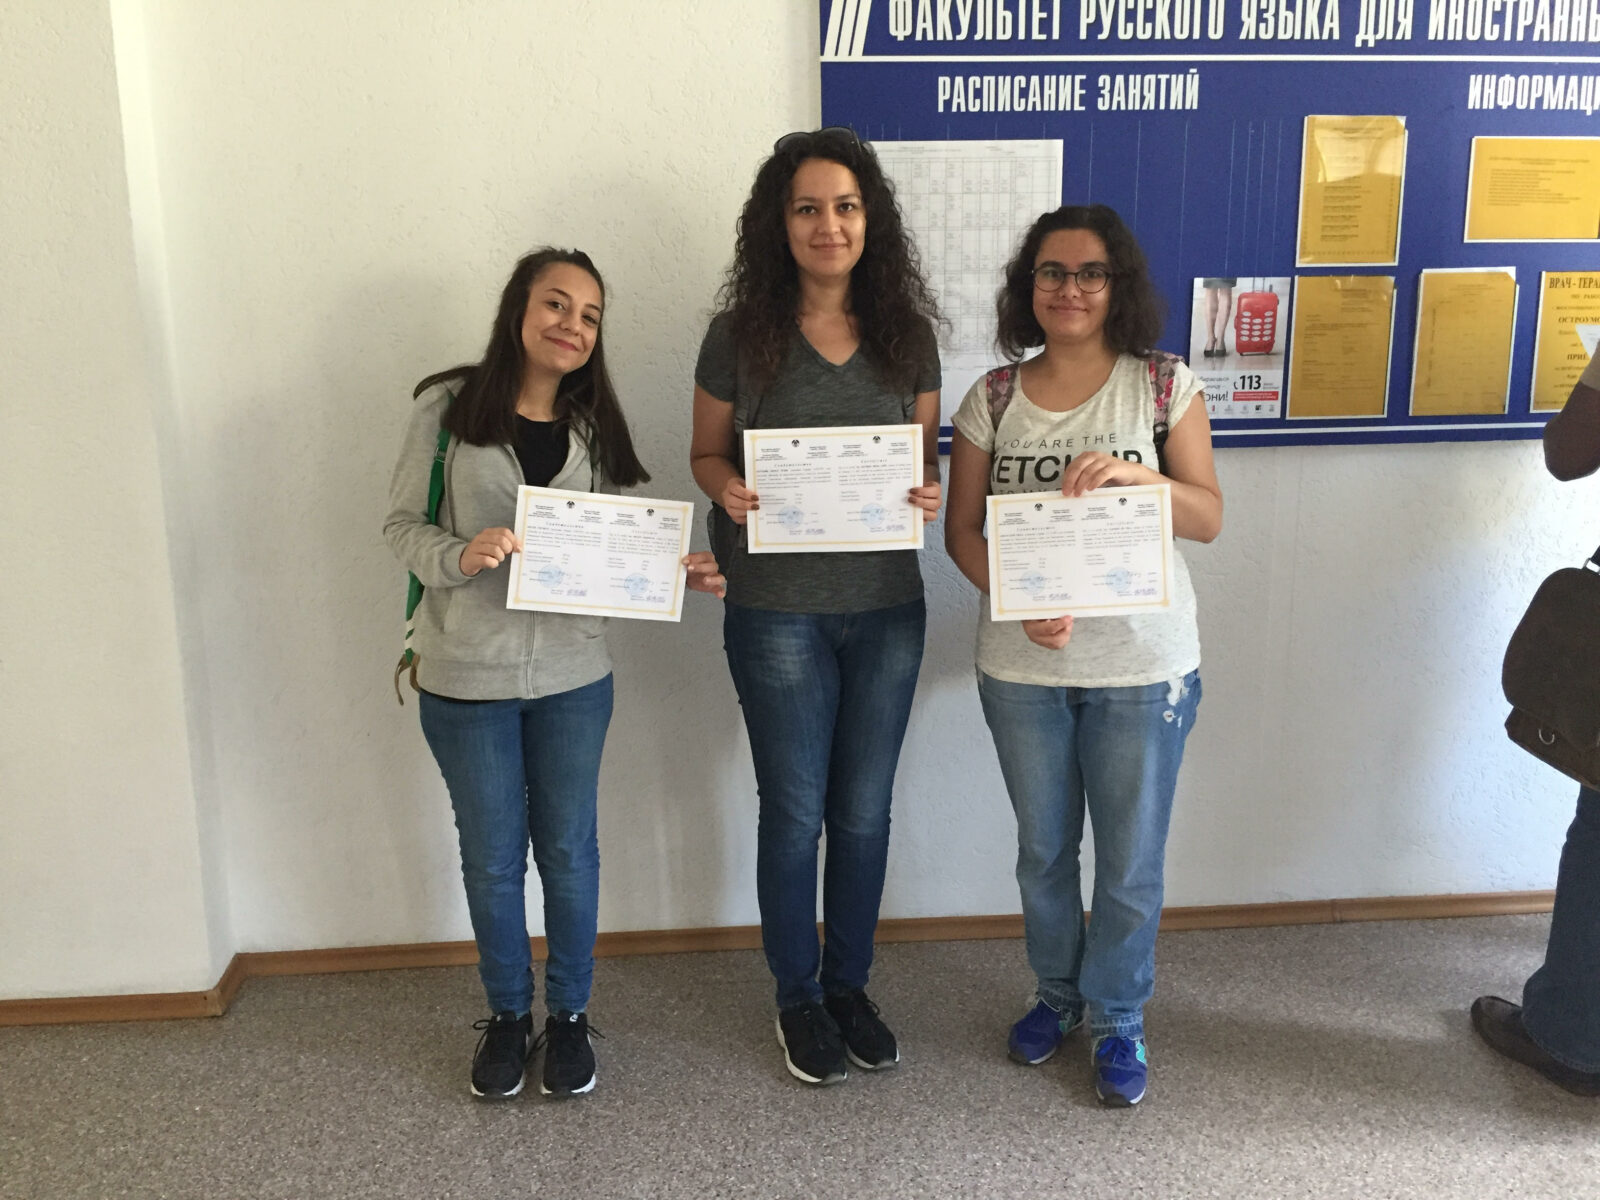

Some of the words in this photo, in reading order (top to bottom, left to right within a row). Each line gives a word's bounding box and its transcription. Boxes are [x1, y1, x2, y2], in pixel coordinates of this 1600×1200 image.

[888, 0, 1060, 41] ФАКУЛЬТЕТ
[1080, 0, 1224, 41] РУССКОГО
[1239, 0, 1340, 41] ЯЗЫКА
[1355, 0, 1413, 48] ДЛЯ
[938, 75, 1086, 112] РАСПИСАНИЕ
[1098, 68, 1199, 111] ЗАНЯТИЙ
[1549, 277, 1571, 288] ВРАЧ
[1578, 277, 1600, 288] ТЕРА
[1239, 374, 1262, 390] 113
[1038, 438, 1075, 449] ARE
[1082, 432, 1117, 446] THE
